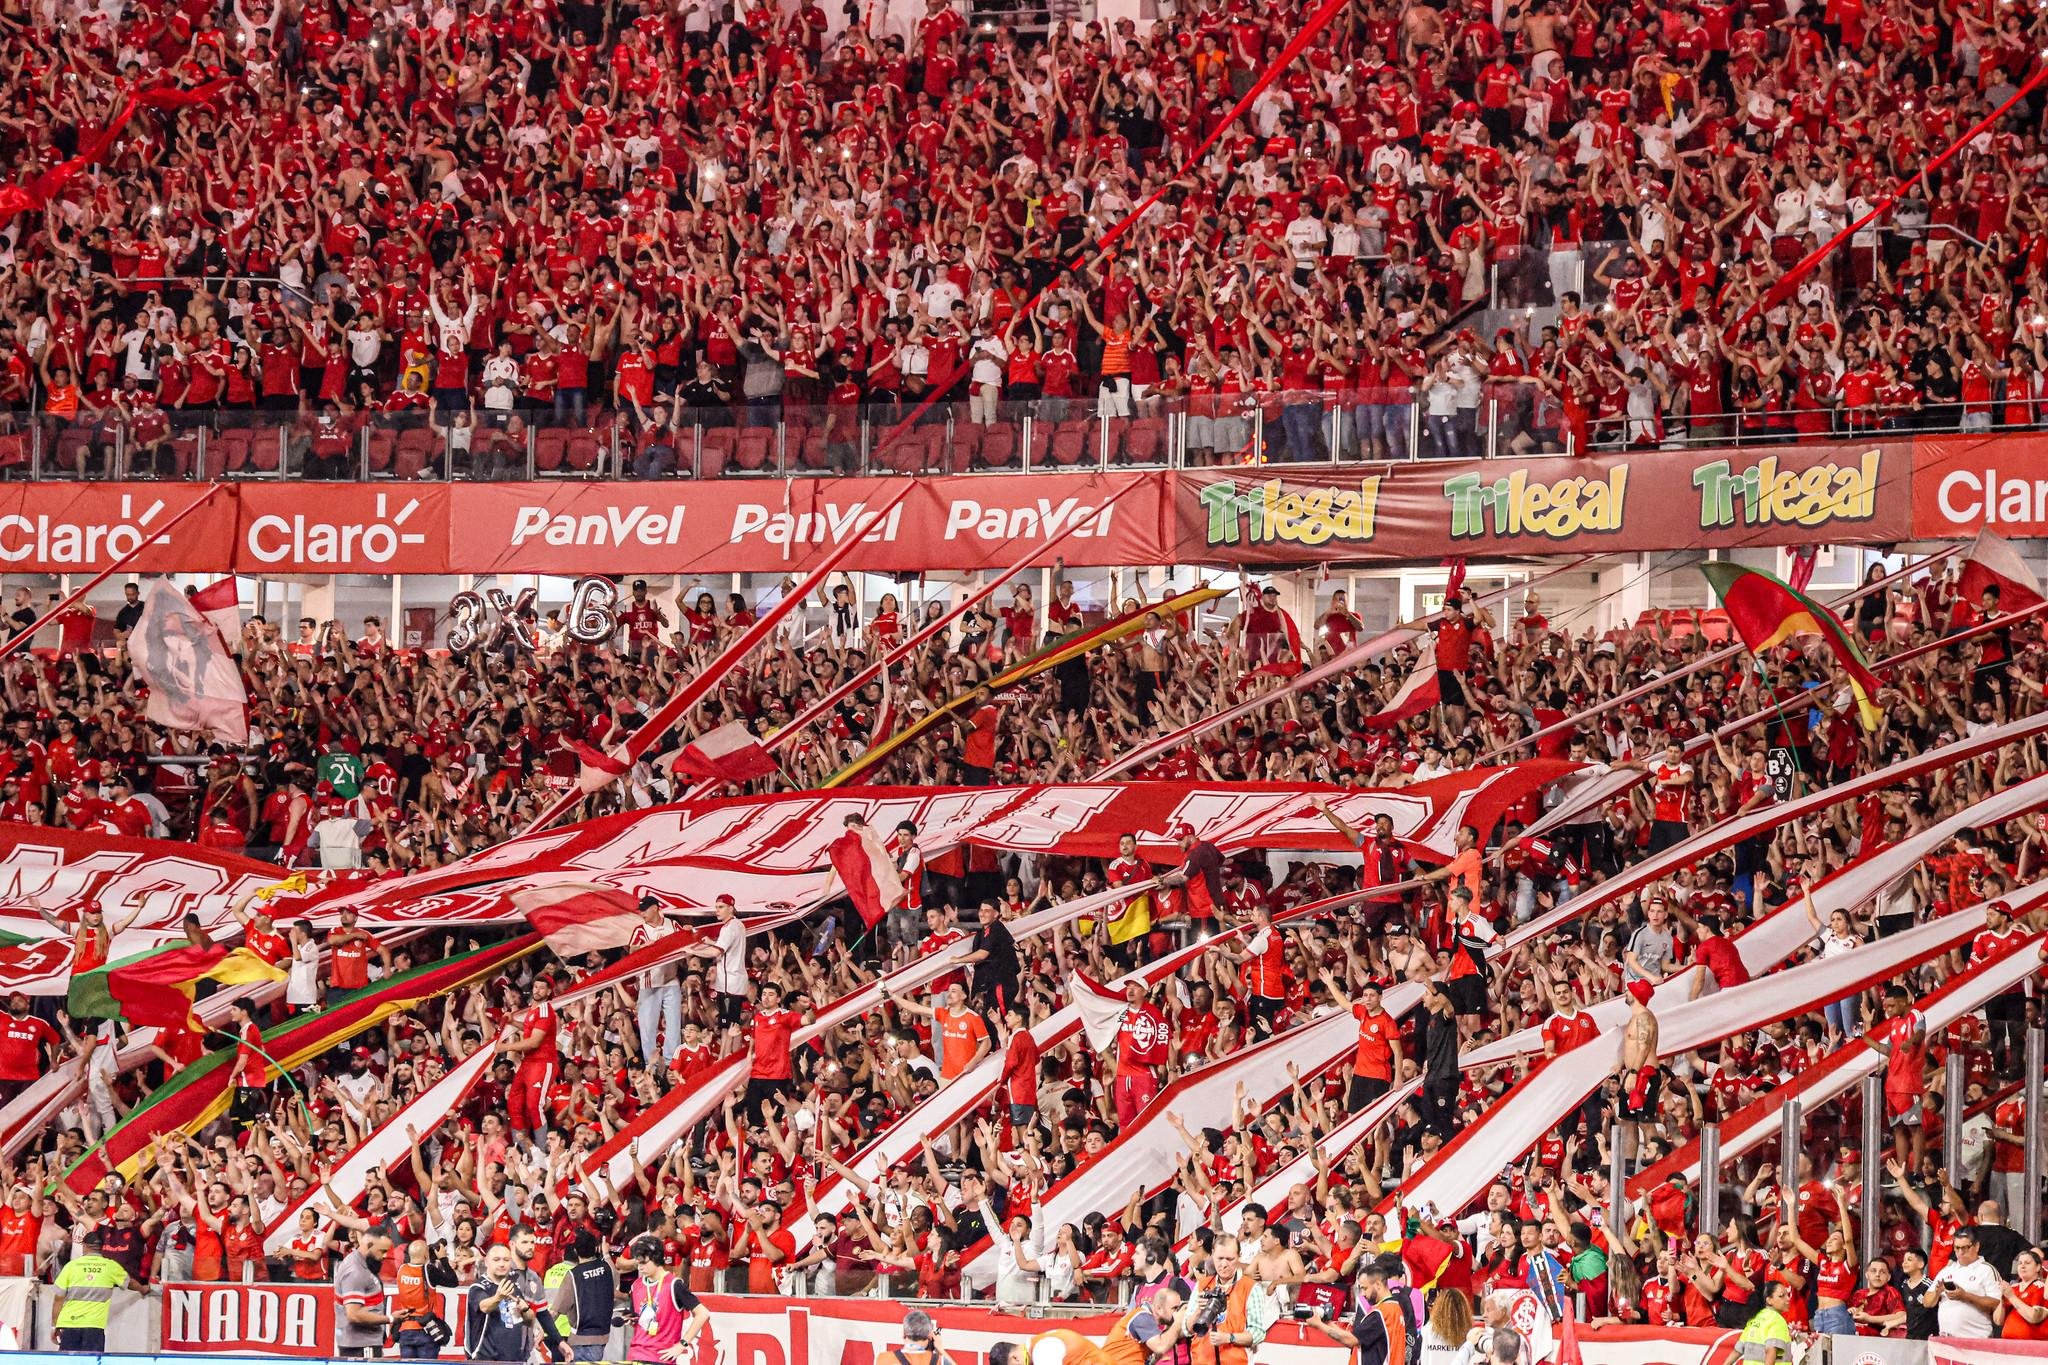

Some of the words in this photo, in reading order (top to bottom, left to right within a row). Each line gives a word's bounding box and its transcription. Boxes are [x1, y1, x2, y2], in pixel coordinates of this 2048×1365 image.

[1200, 475, 1381, 545] Trilegal
[1444, 463, 1629, 540] Trilegal
[1693, 449, 1881, 530] Trilegal
[0, 515, 140, 563] Claro
[248, 515, 398, 563] Claro
[512, 505, 685, 546] PanVel
[730, 500, 904, 545] PanVel
[945, 496, 1116, 541] PanVel
[329, 763, 355, 785] 24
[1768, 760, 1781, 775] B
[1157, 1023, 1169, 1045] 1909
[400, 1275, 421, 1286] FOTO
[582, 1266, 606, 1280] STAFF
[168, 1288, 317, 1348] NADA
